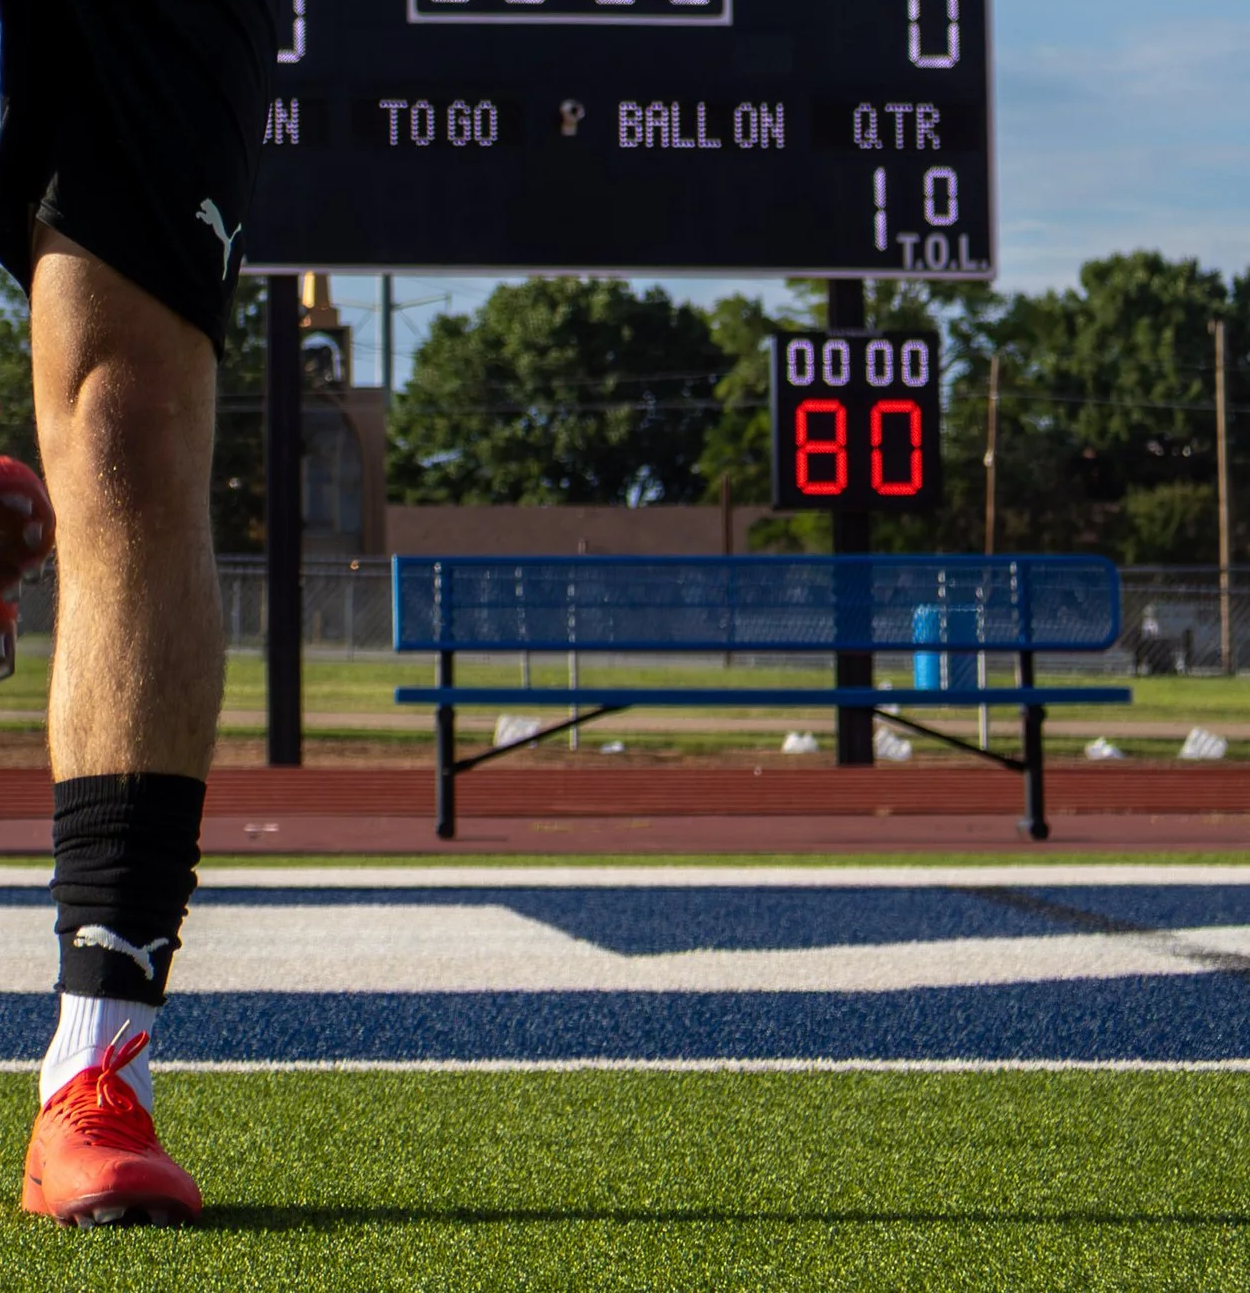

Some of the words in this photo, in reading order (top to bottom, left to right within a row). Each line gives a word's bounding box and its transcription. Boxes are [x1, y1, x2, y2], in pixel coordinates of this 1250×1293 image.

[619, 101, 722, 149] BALL
[734, 102, 786, 149] ON
[853, 103, 941, 150] QTR
[794, 398, 924, 497] 80
